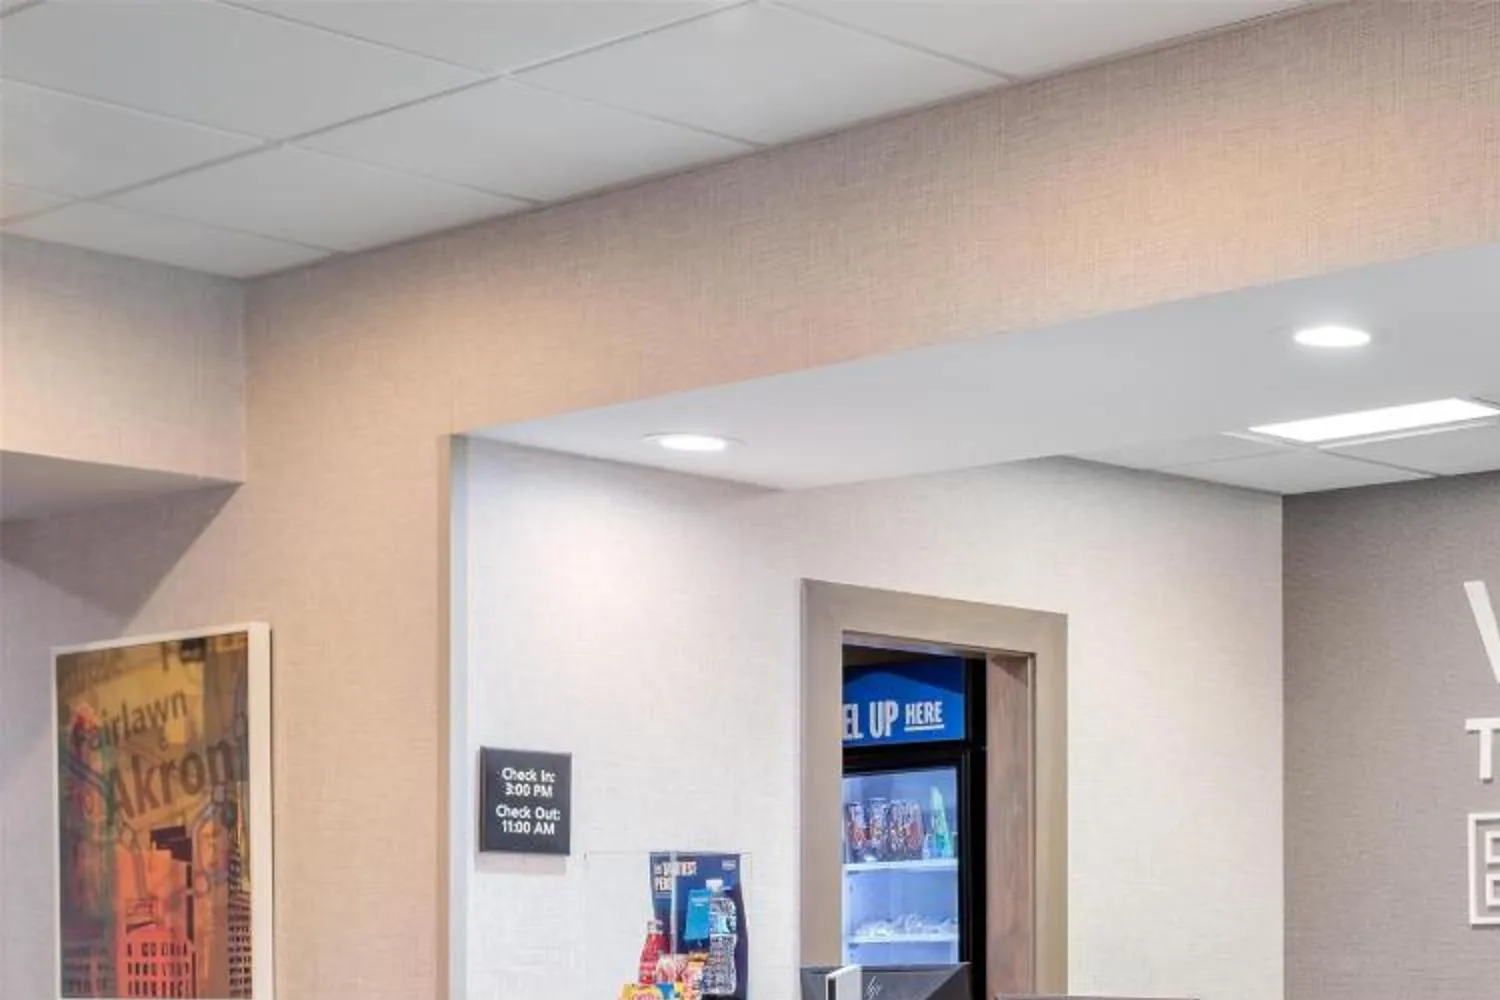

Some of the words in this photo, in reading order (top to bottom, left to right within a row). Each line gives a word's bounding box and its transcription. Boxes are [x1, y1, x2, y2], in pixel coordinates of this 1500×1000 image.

[869, 700, 899, 738] UP
[905, 701, 943, 724] HERE
[501, 767, 536, 782] Check
[541, 769, 556, 782] In:
[107, 740, 234, 827] Akron
[505, 782, 531, 797] 3:00
[533, 783, 553, 797] PM
[496, 804, 531, 819] Check
[535, 806, 561, 820] Out:
[502, 819, 531, 833] 11:00
[533, 822, 555, 834] AM
